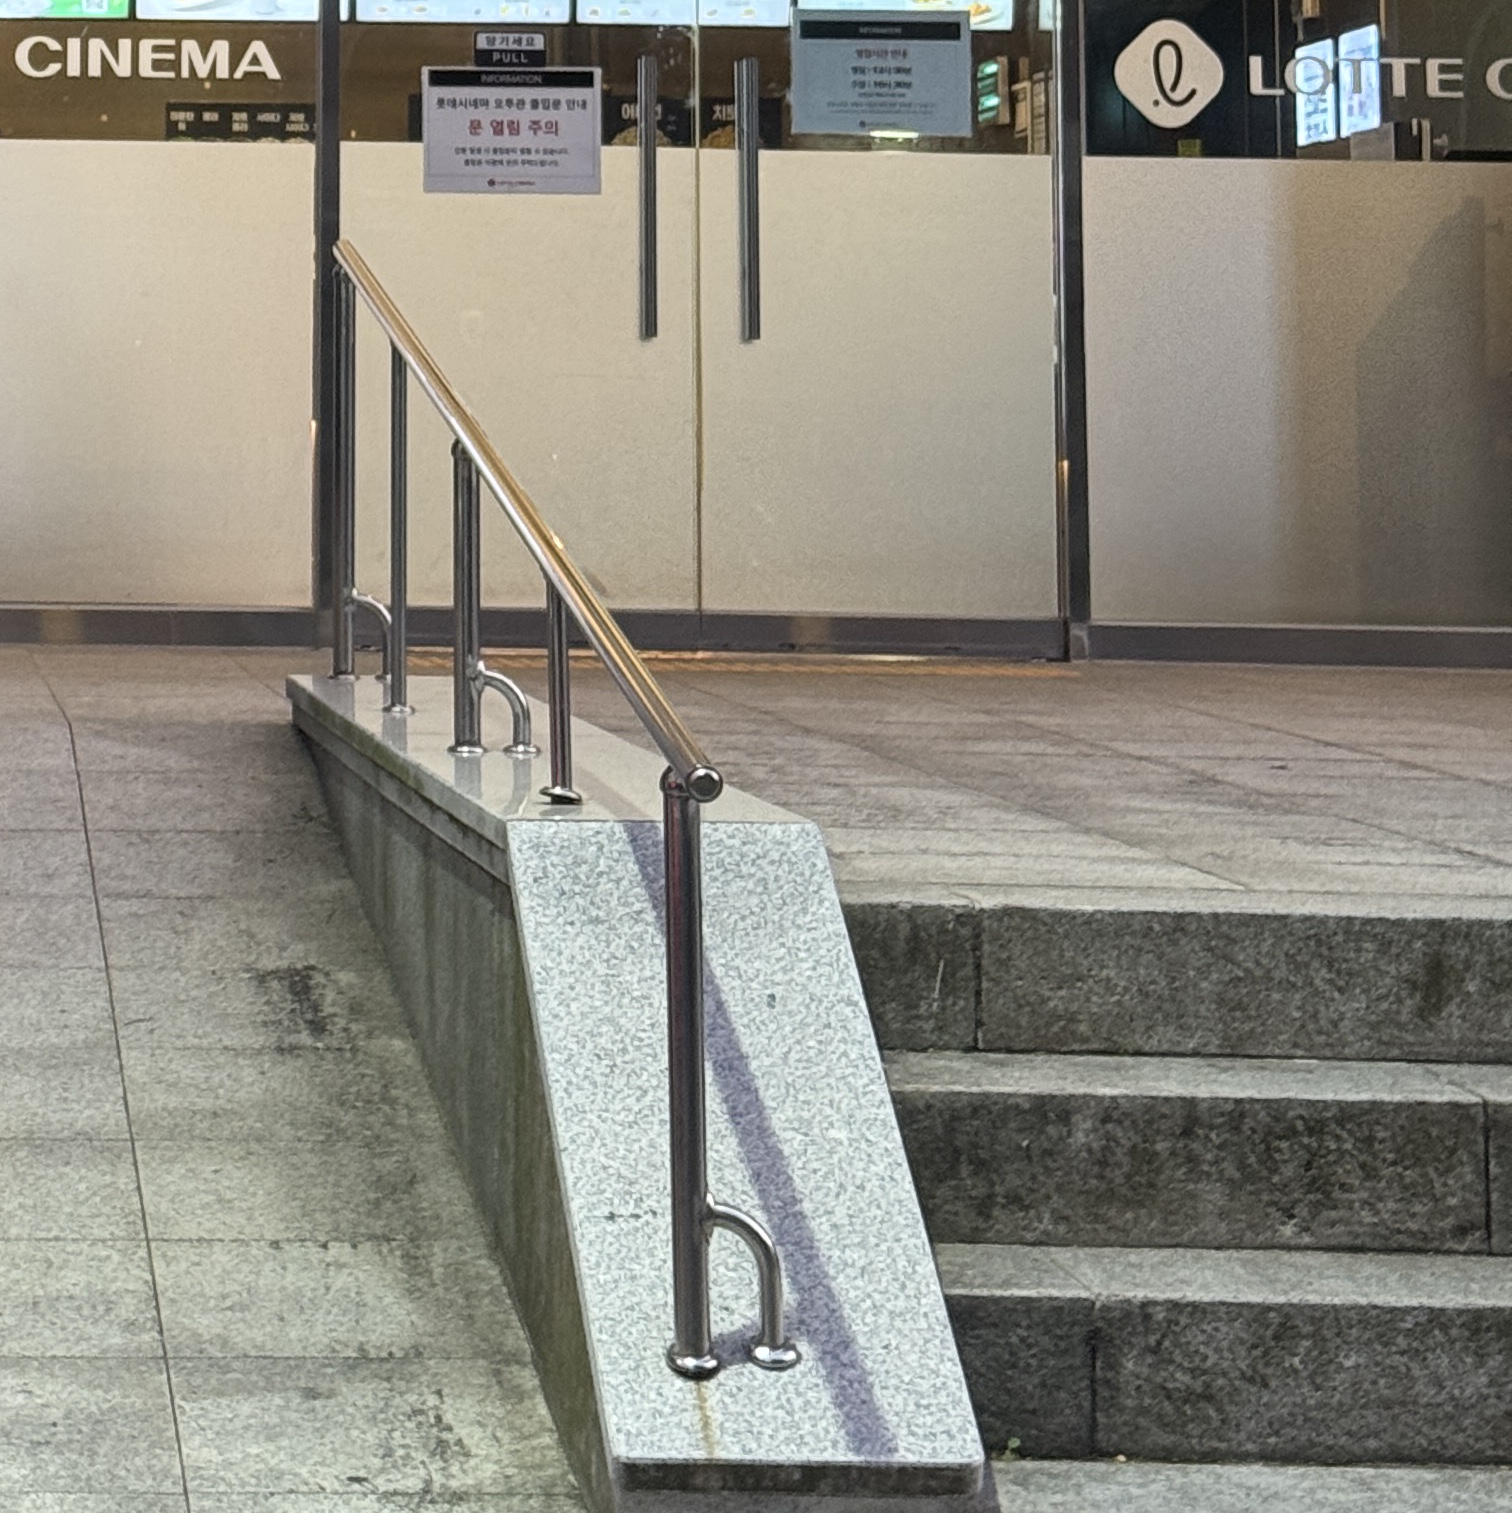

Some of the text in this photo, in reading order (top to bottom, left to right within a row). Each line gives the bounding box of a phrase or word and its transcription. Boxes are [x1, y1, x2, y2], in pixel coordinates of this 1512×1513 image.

[14, 35, 282, 82] CINEMA
[492, 52, 529, 64] PULL
[1249, 54, 1465, 99] LOTTE
[527, 119, 560, 137] 주의
